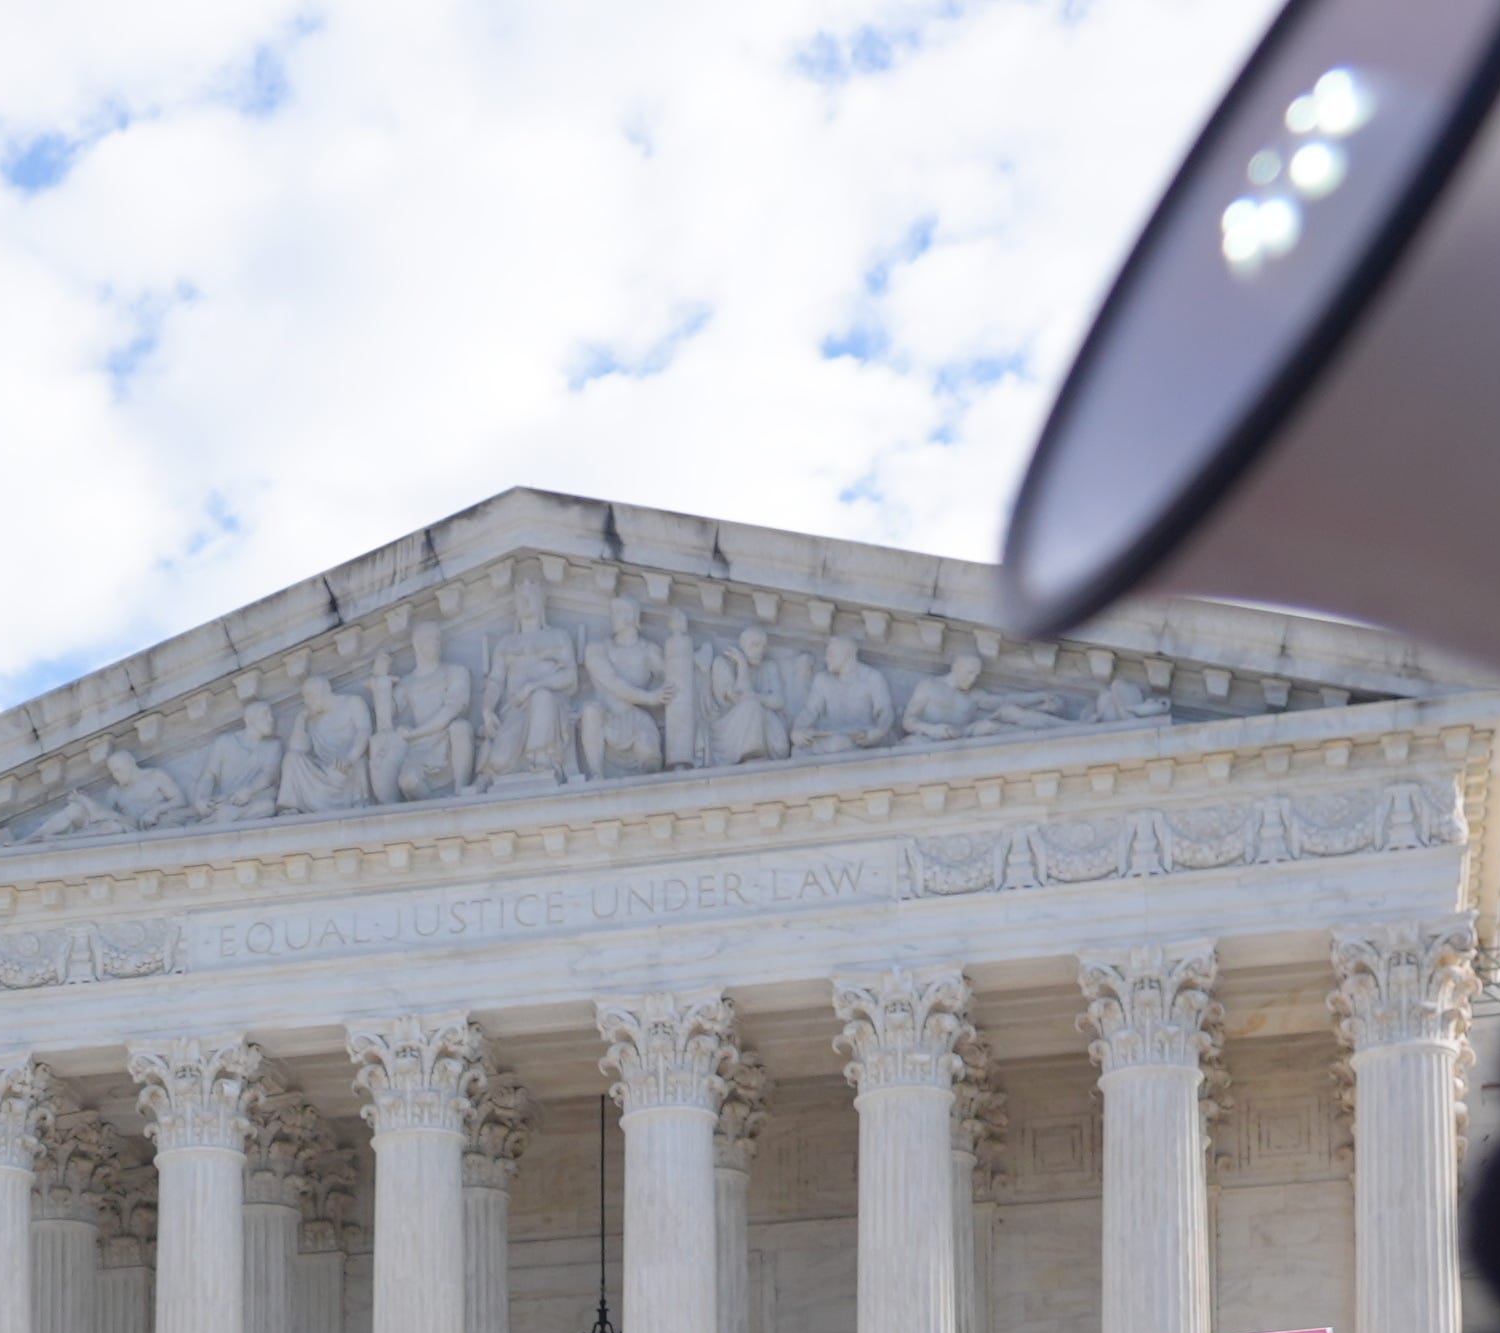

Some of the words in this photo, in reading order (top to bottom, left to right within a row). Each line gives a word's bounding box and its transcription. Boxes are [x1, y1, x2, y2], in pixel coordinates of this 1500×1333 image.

[218, 917, 373, 958] EQUAL
[381, 892, 565, 942] JUSTICE
[590, 872, 750, 919] UNDER
[770, 860, 865, 902] LAW
